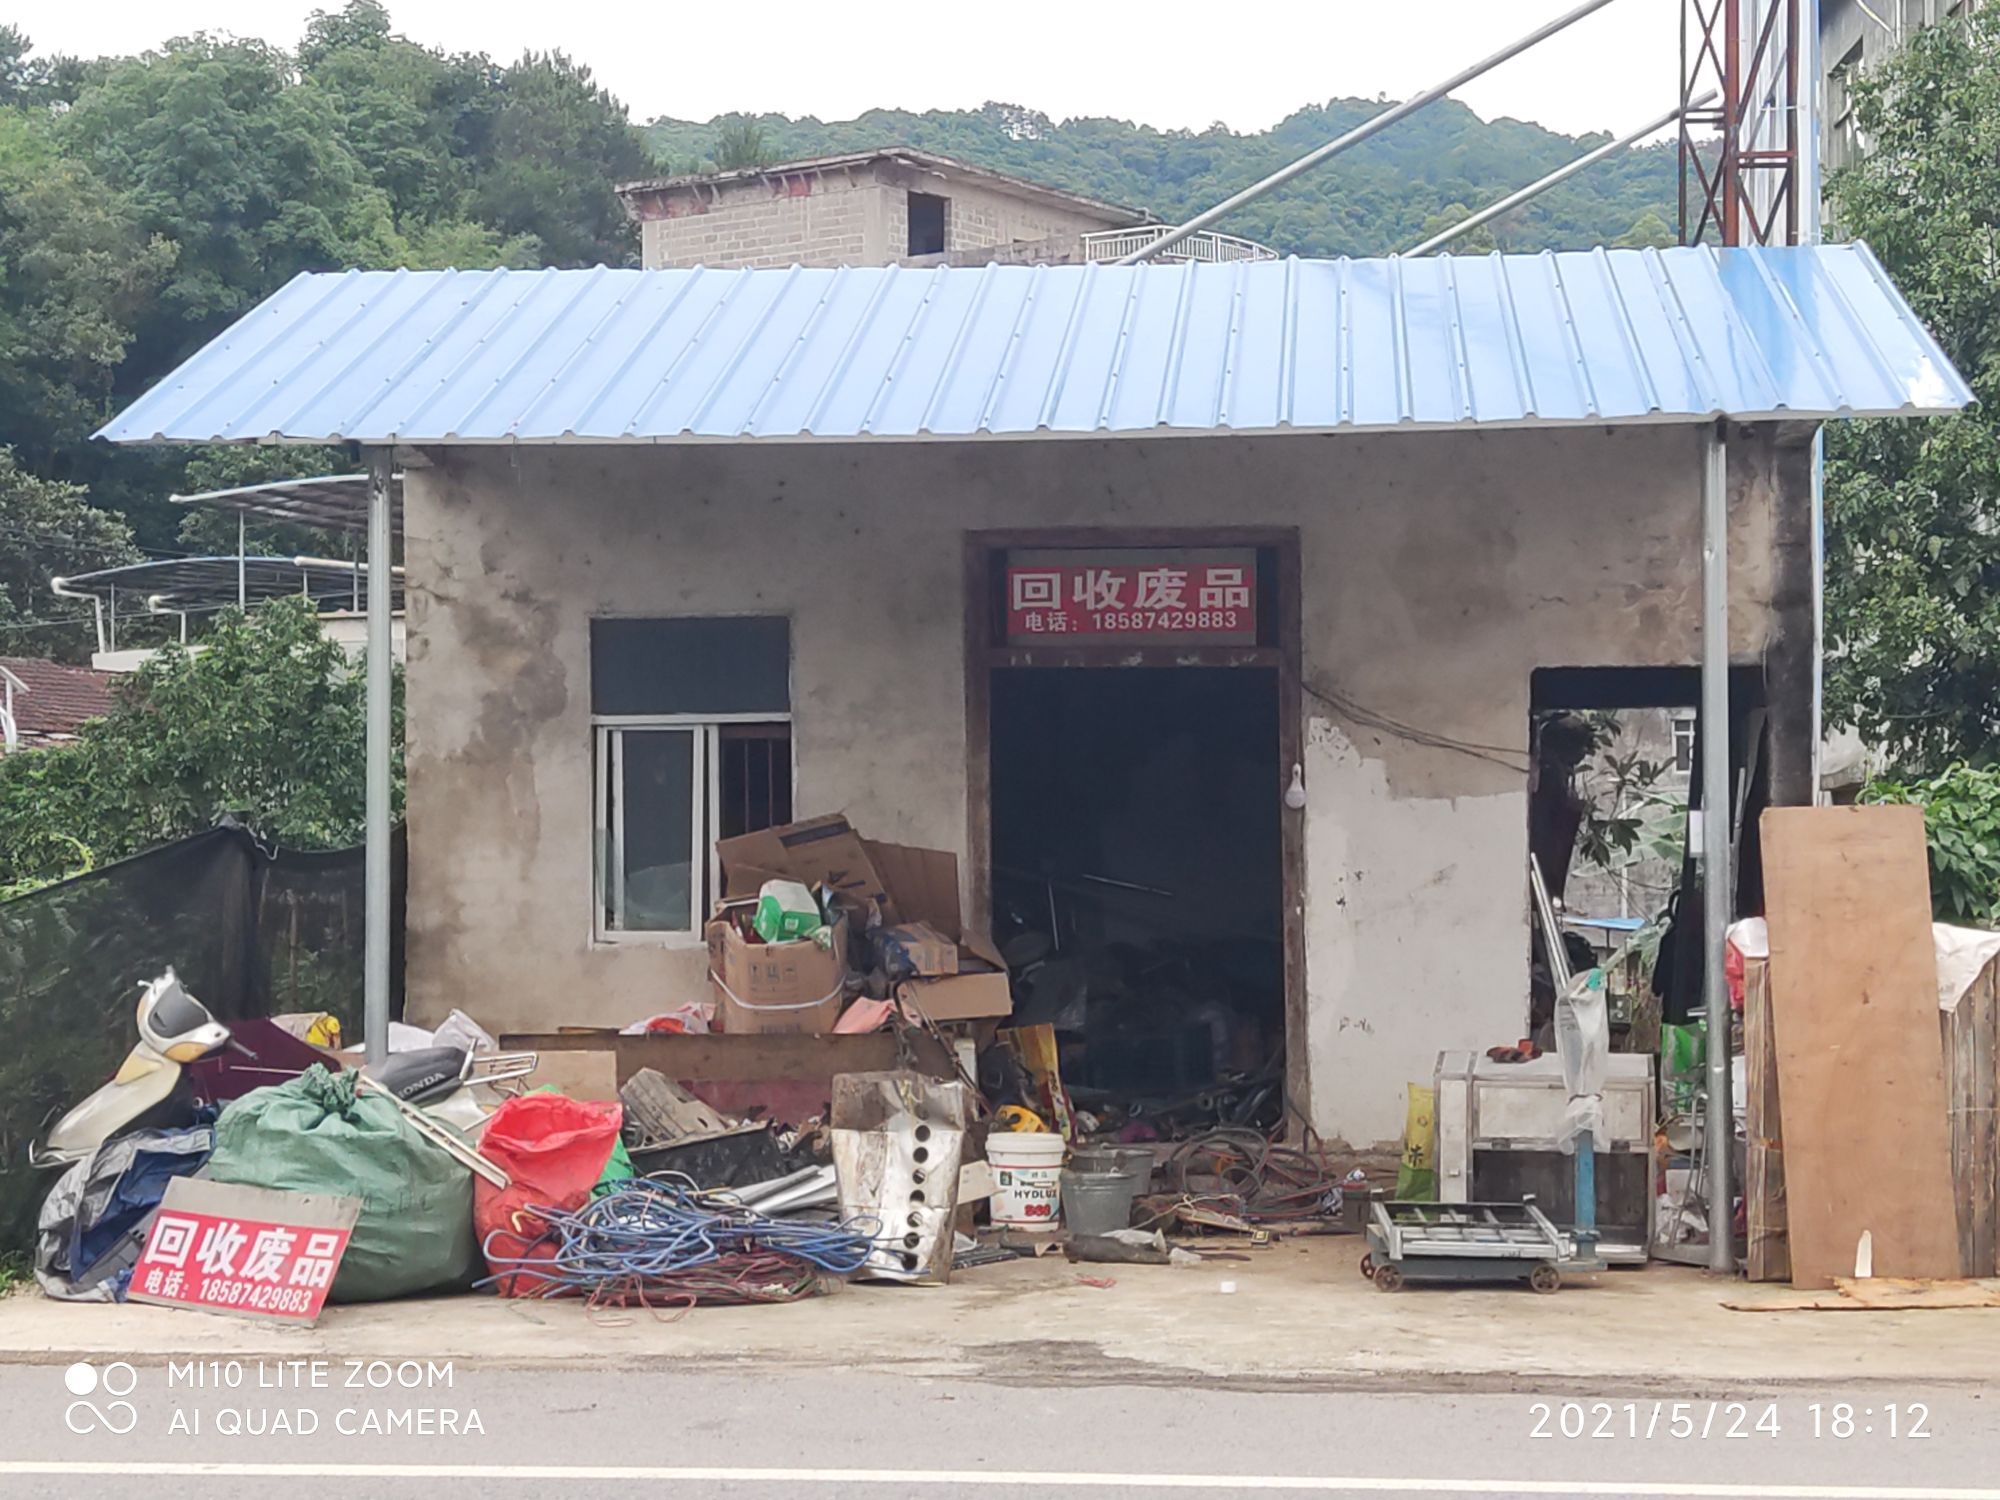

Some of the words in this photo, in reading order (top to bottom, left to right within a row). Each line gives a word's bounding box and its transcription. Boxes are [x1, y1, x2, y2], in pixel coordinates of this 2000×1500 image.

[1012, 568, 1249, 610] 回收废品
[144, 1216, 339, 1288] 回收废品
